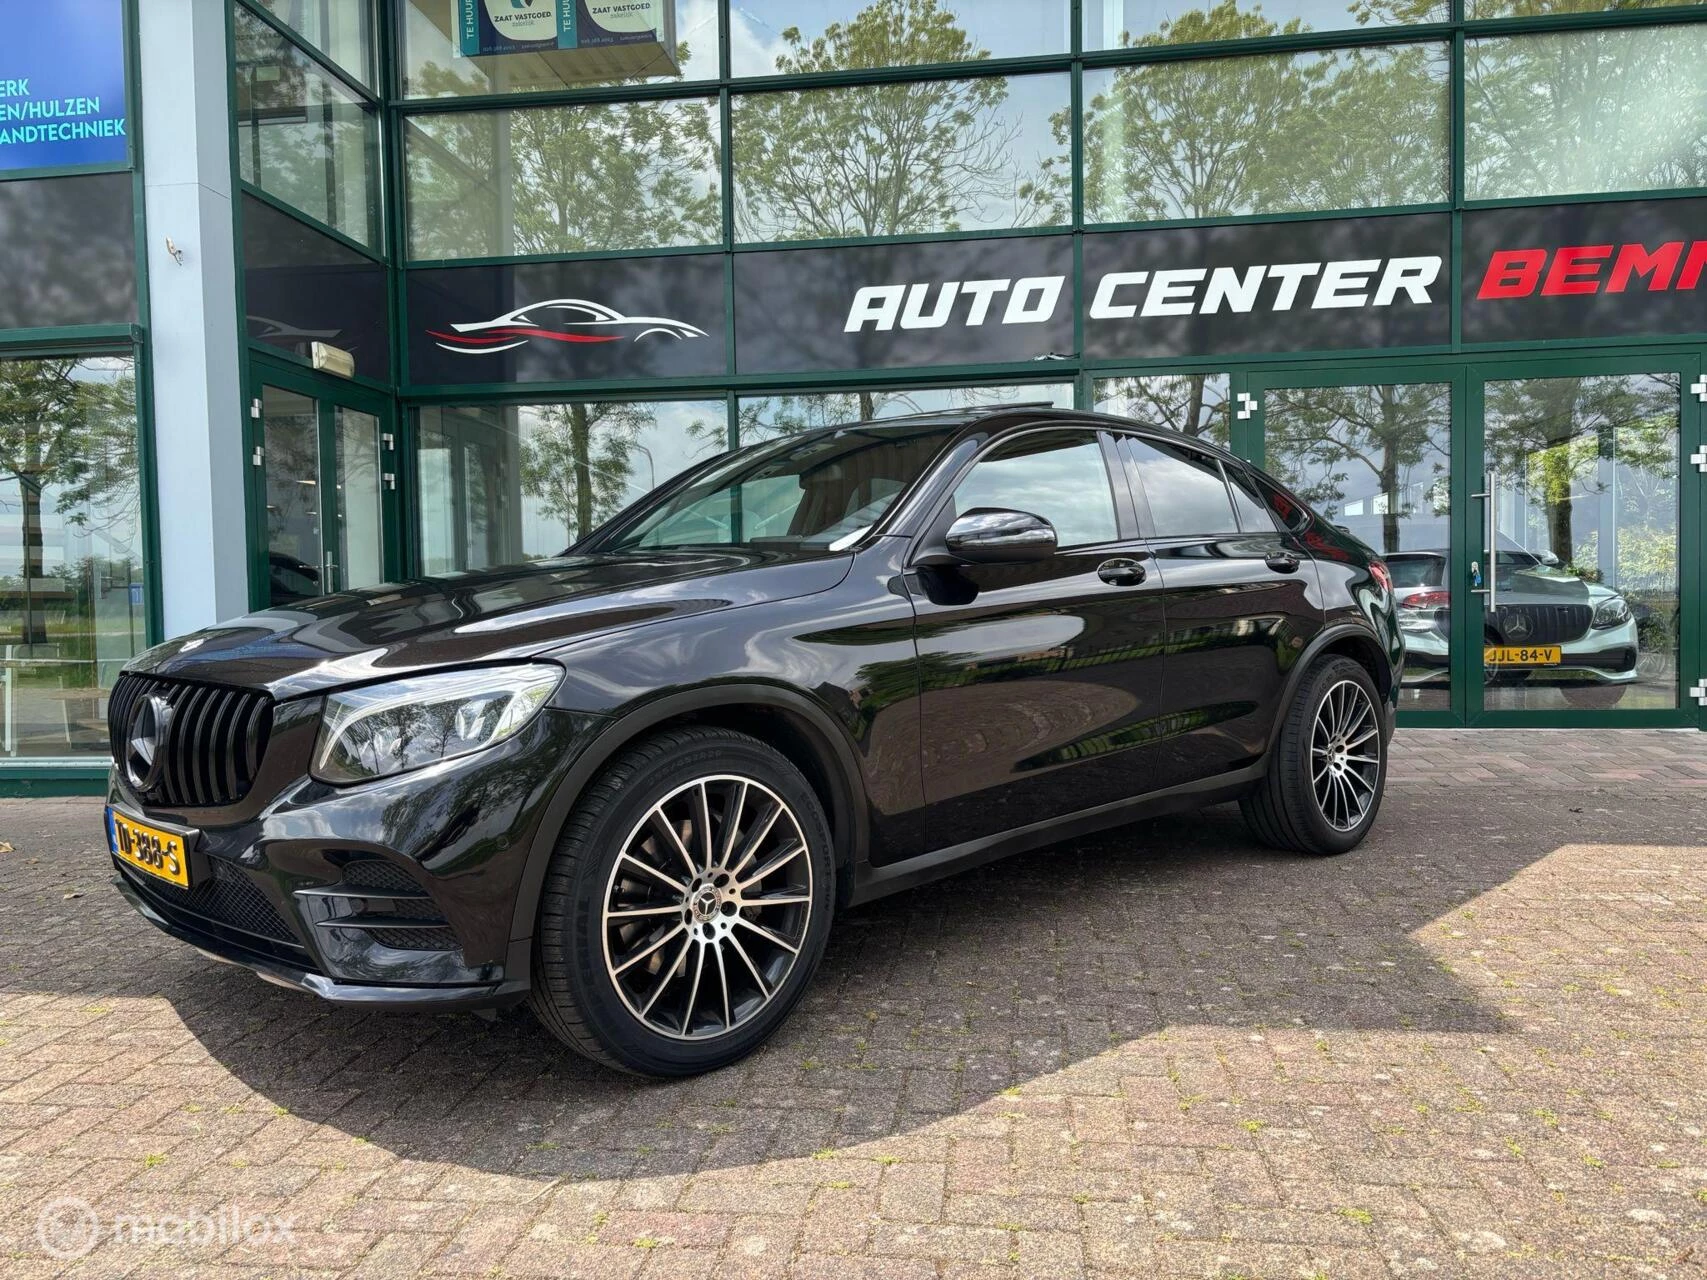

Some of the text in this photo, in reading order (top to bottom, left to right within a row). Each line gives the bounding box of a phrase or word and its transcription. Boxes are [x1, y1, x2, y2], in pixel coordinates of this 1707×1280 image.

[592, 2, 651, 14] ZAAT VASTGOED
[494, 11, 552, 22] ZAAT VASTGOED
[562, 19, 572, 33] TE
[466, 27, 475, 40] TE
[0, 96, 100, 121] EN/HULZEN
[0, 118, 126, 144] ANDTECHNIEK
[844, 276, 1065, 333] AUTO
[1089, 256, 1442, 319] CENTER
[1489, 649, 1553, 662] JJL-84-V
